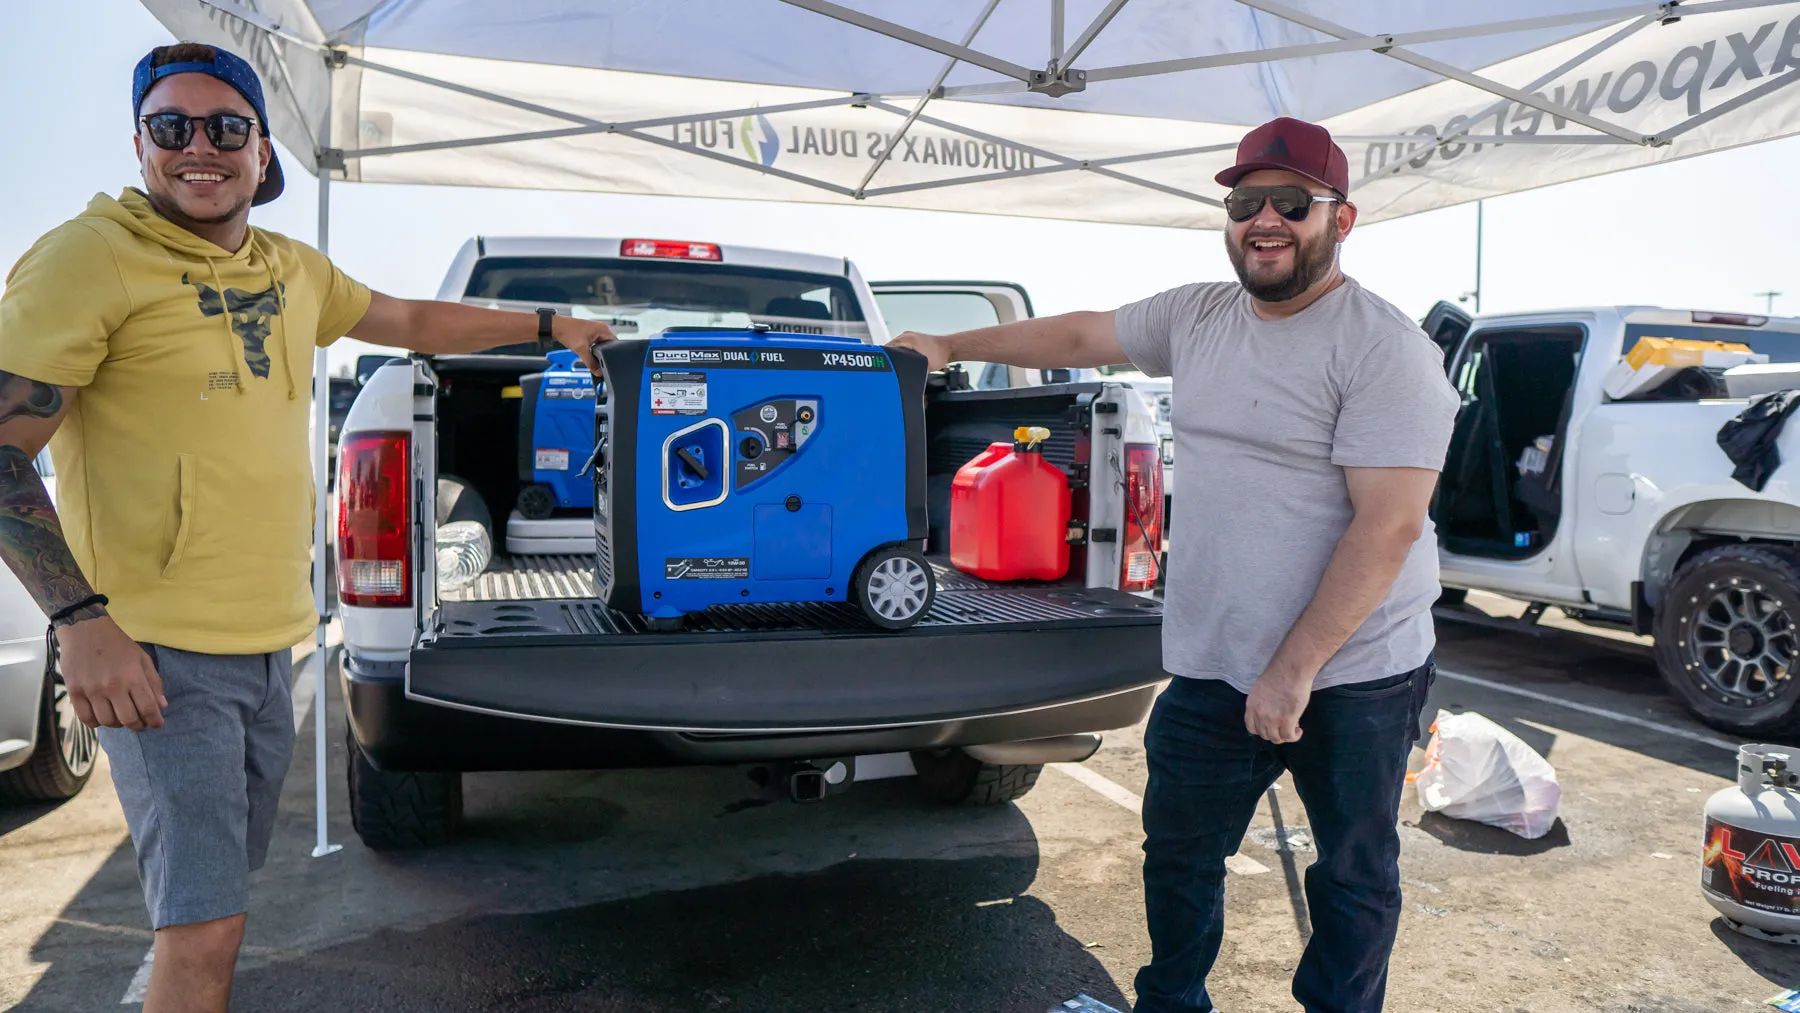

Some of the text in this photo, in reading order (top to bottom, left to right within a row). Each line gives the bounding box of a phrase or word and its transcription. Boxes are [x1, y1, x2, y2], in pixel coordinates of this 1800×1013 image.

[723, 351, 750, 361] DUAL
[760, 352, 785, 362] FUEL
[822, 352, 885, 368] XP4500iH
